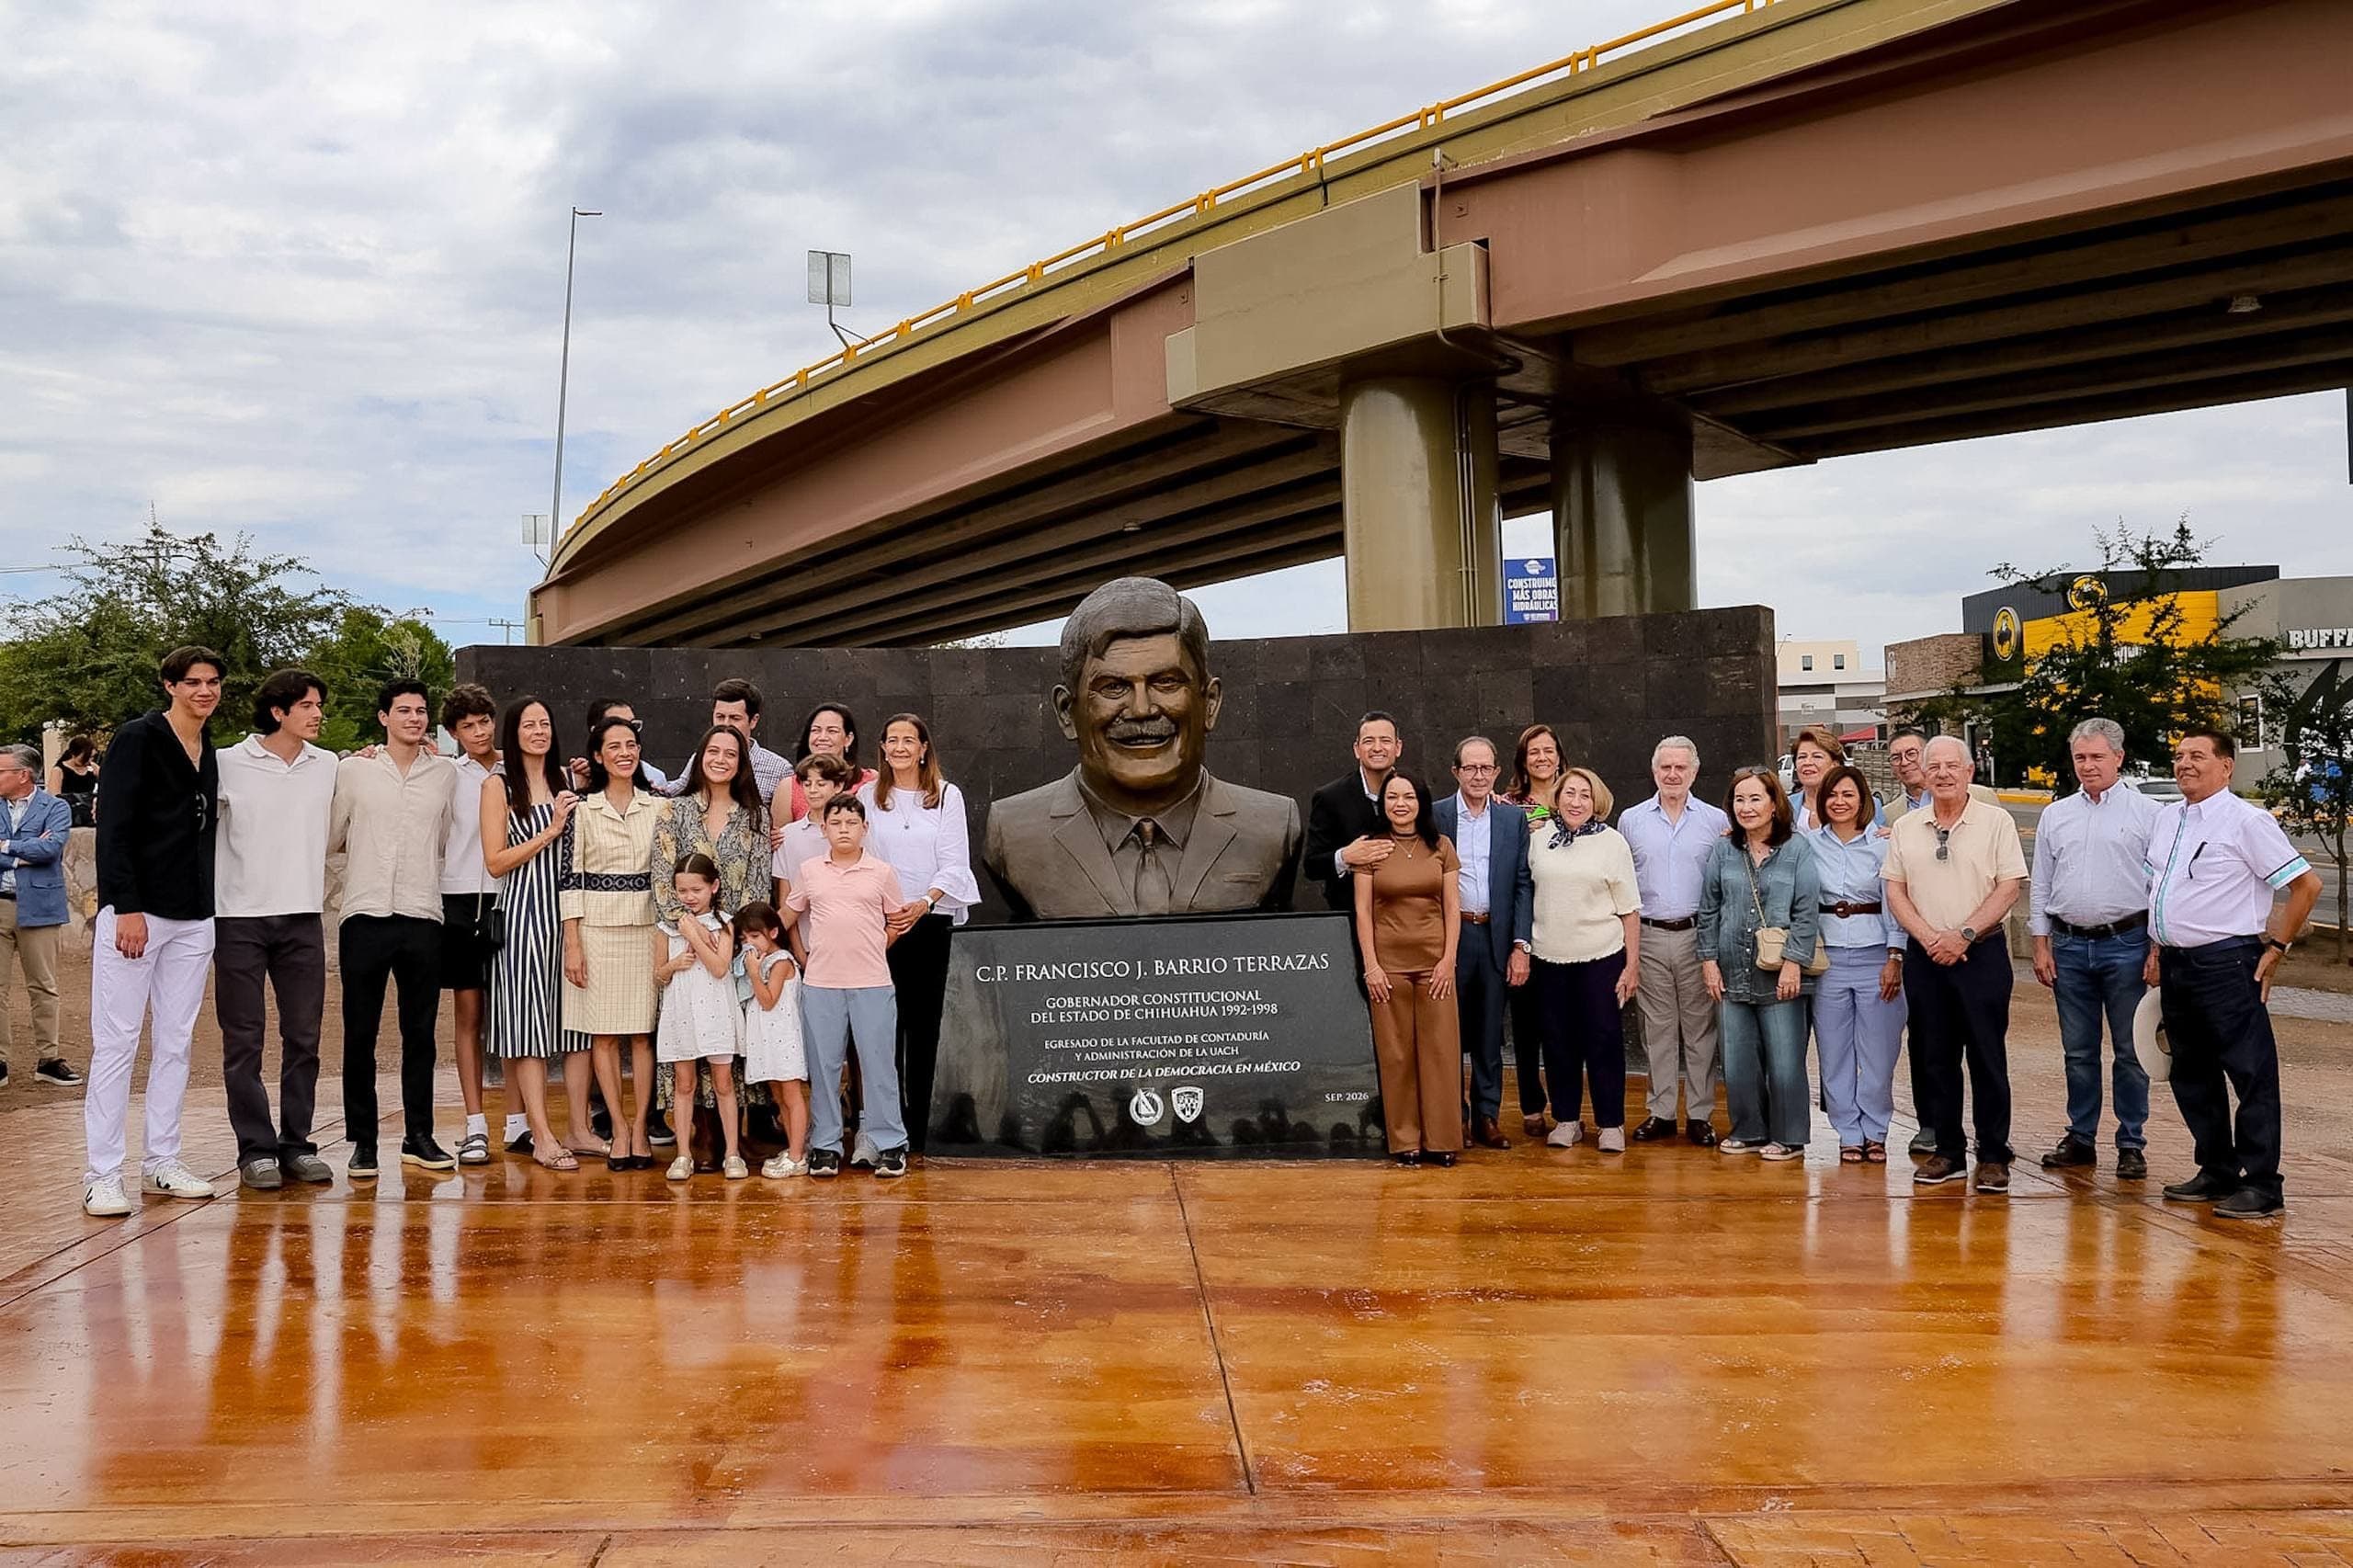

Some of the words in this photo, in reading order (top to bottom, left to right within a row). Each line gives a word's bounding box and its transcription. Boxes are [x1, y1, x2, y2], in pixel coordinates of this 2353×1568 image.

[1512, 588, 1530, 600] MÁS
[1531, 588, 1557, 600] OBRAS
[1512, 599, 1558, 611] HIDRÁULICAS
[976, 965, 1008, 982] C.P.
[1016, 960, 1130, 981] FRANCISCO
[1135, 960, 1147, 980] J.
[1154, 957, 1227, 975] BARRIO
[1233, 953, 1329, 972] TERRAZAS
[1046, 994, 1140, 1009] GOBERNADOR
[1142, 990, 1261, 1005] CONSTITUCIONAL
[1031, 1012, 1055, 1024] DEL
[1060, 1010, 1109, 1023] ESTADO
[1114, 1009, 1131, 1020] DE
[1134, 1006, 1218, 1019] CHIHUAHUA
[1222, 1004, 1278, 1016] 1992-1998
[1044, 1038, 1097, 1050] EGRESADO
[1101, 1038, 1114, 1047] DE
[1117, 1037, 1129, 1046] LA
[1131, 1034, 1182, 1046] FACULTAD
[1185, 1034, 1199, 1044] DE
[1200, 1030, 1269, 1043] CONTADURÍA
[1074, 1052, 1083, 1062] Y
[1084, 1048, 1176, 1062] ADMINISTRACIÓN
[1179, 1048, 1193, 1057] DE
[1196, 1047, 1208, 1056] LA
[1210, 1046, 1239, 1056] UACH
[1028, 1069, 1118, 1084] CONSTRUCTOR
[1120, 1068, 1136, 1080] DE
[1138, 1067, 1152, 1078] LA
[1154, 1063, 1233, 1077] DEMOCRACIA
[1235, 1063, 1251, 1074] EN
[1253, 1060, 1302, 1073] MÉXICO
[1324, 1092, 1344, 1102] SEP.
[1346, 1092, 1370, 1101] 2026
